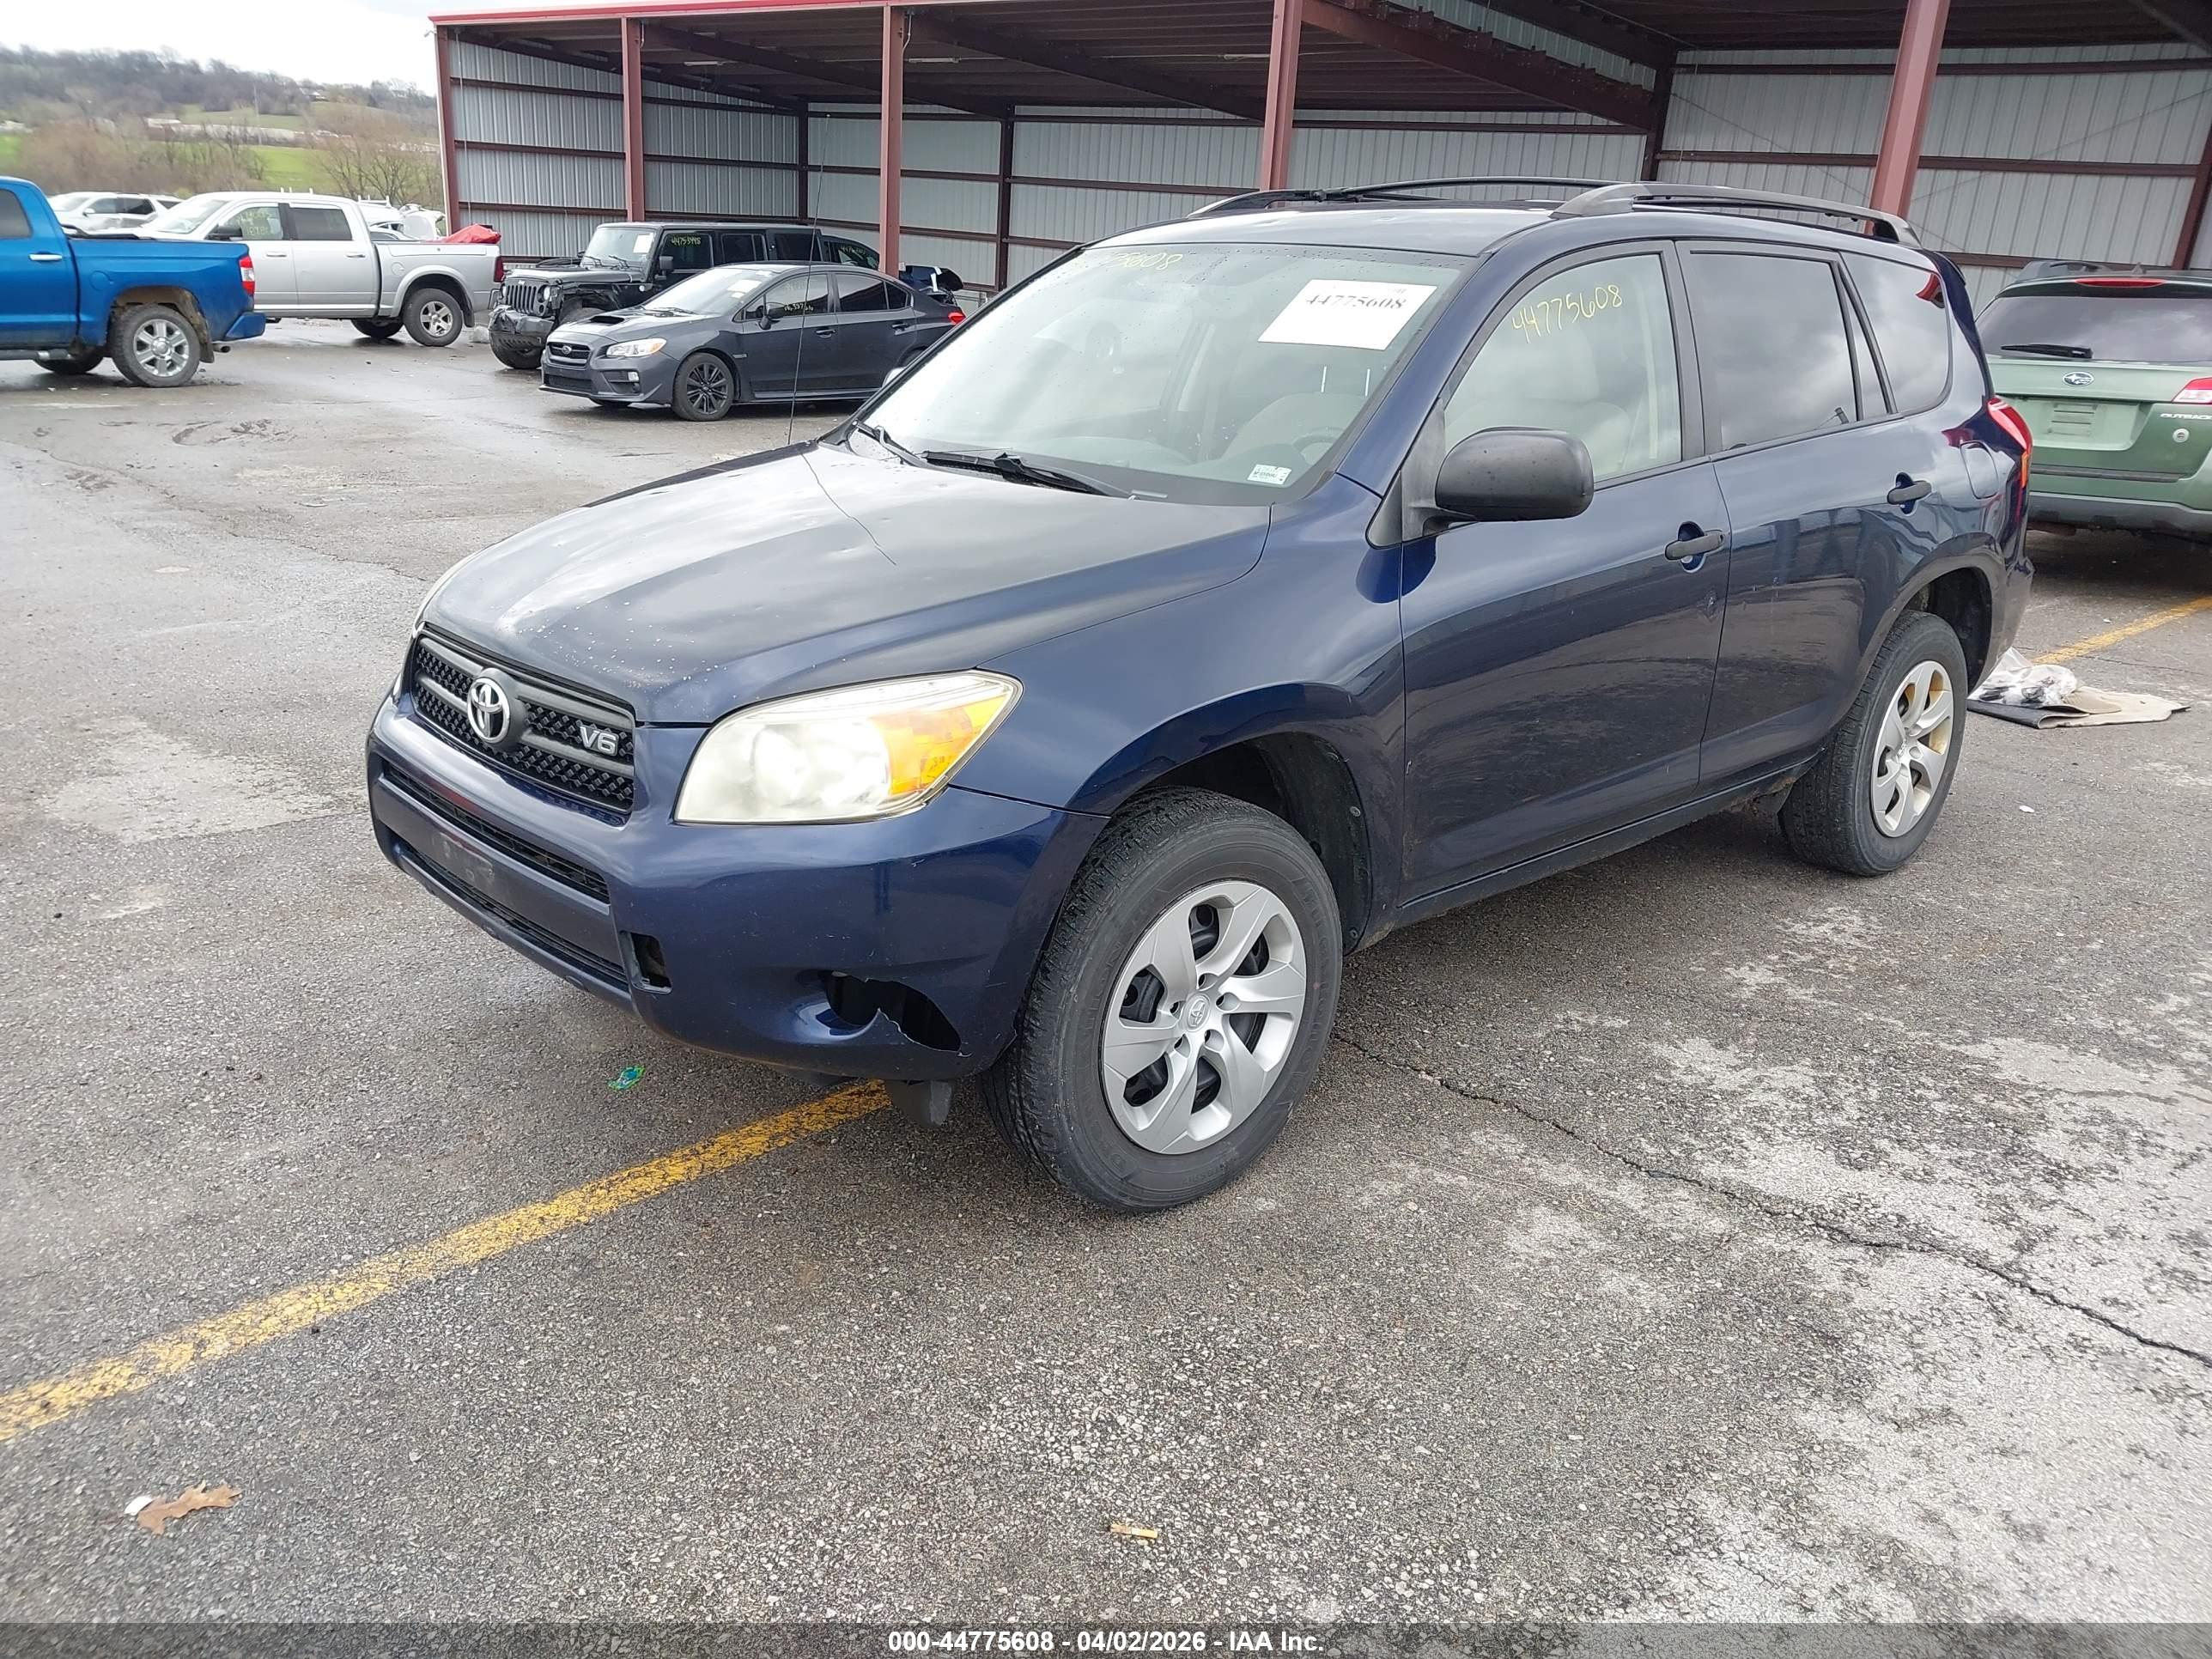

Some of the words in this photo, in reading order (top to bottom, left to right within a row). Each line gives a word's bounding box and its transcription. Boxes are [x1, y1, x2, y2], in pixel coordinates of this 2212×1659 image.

[1305, 294, 1407, 310] 44775608
[1511, 284, 1623, 343] 44775608
[579, 725, 618, 755] V6
